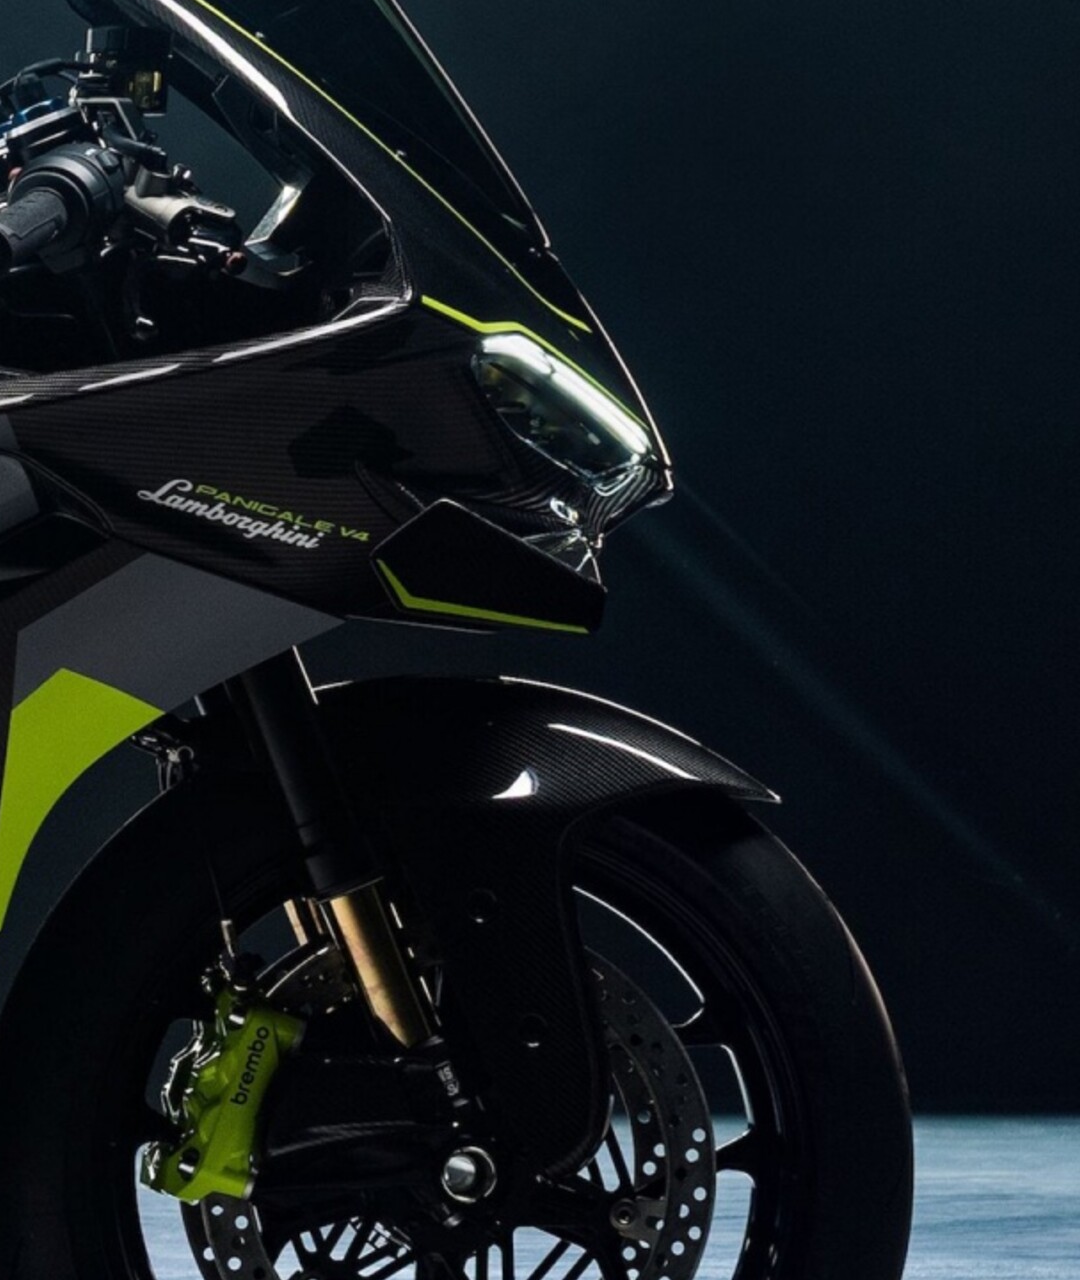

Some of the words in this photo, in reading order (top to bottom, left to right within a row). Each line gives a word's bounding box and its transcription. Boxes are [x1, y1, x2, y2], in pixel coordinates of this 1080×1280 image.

[137, 479, 325, 549] Lamborghini
[340, 526, 370, 542] V4
[230, 1026, 269, 1106] brembo
